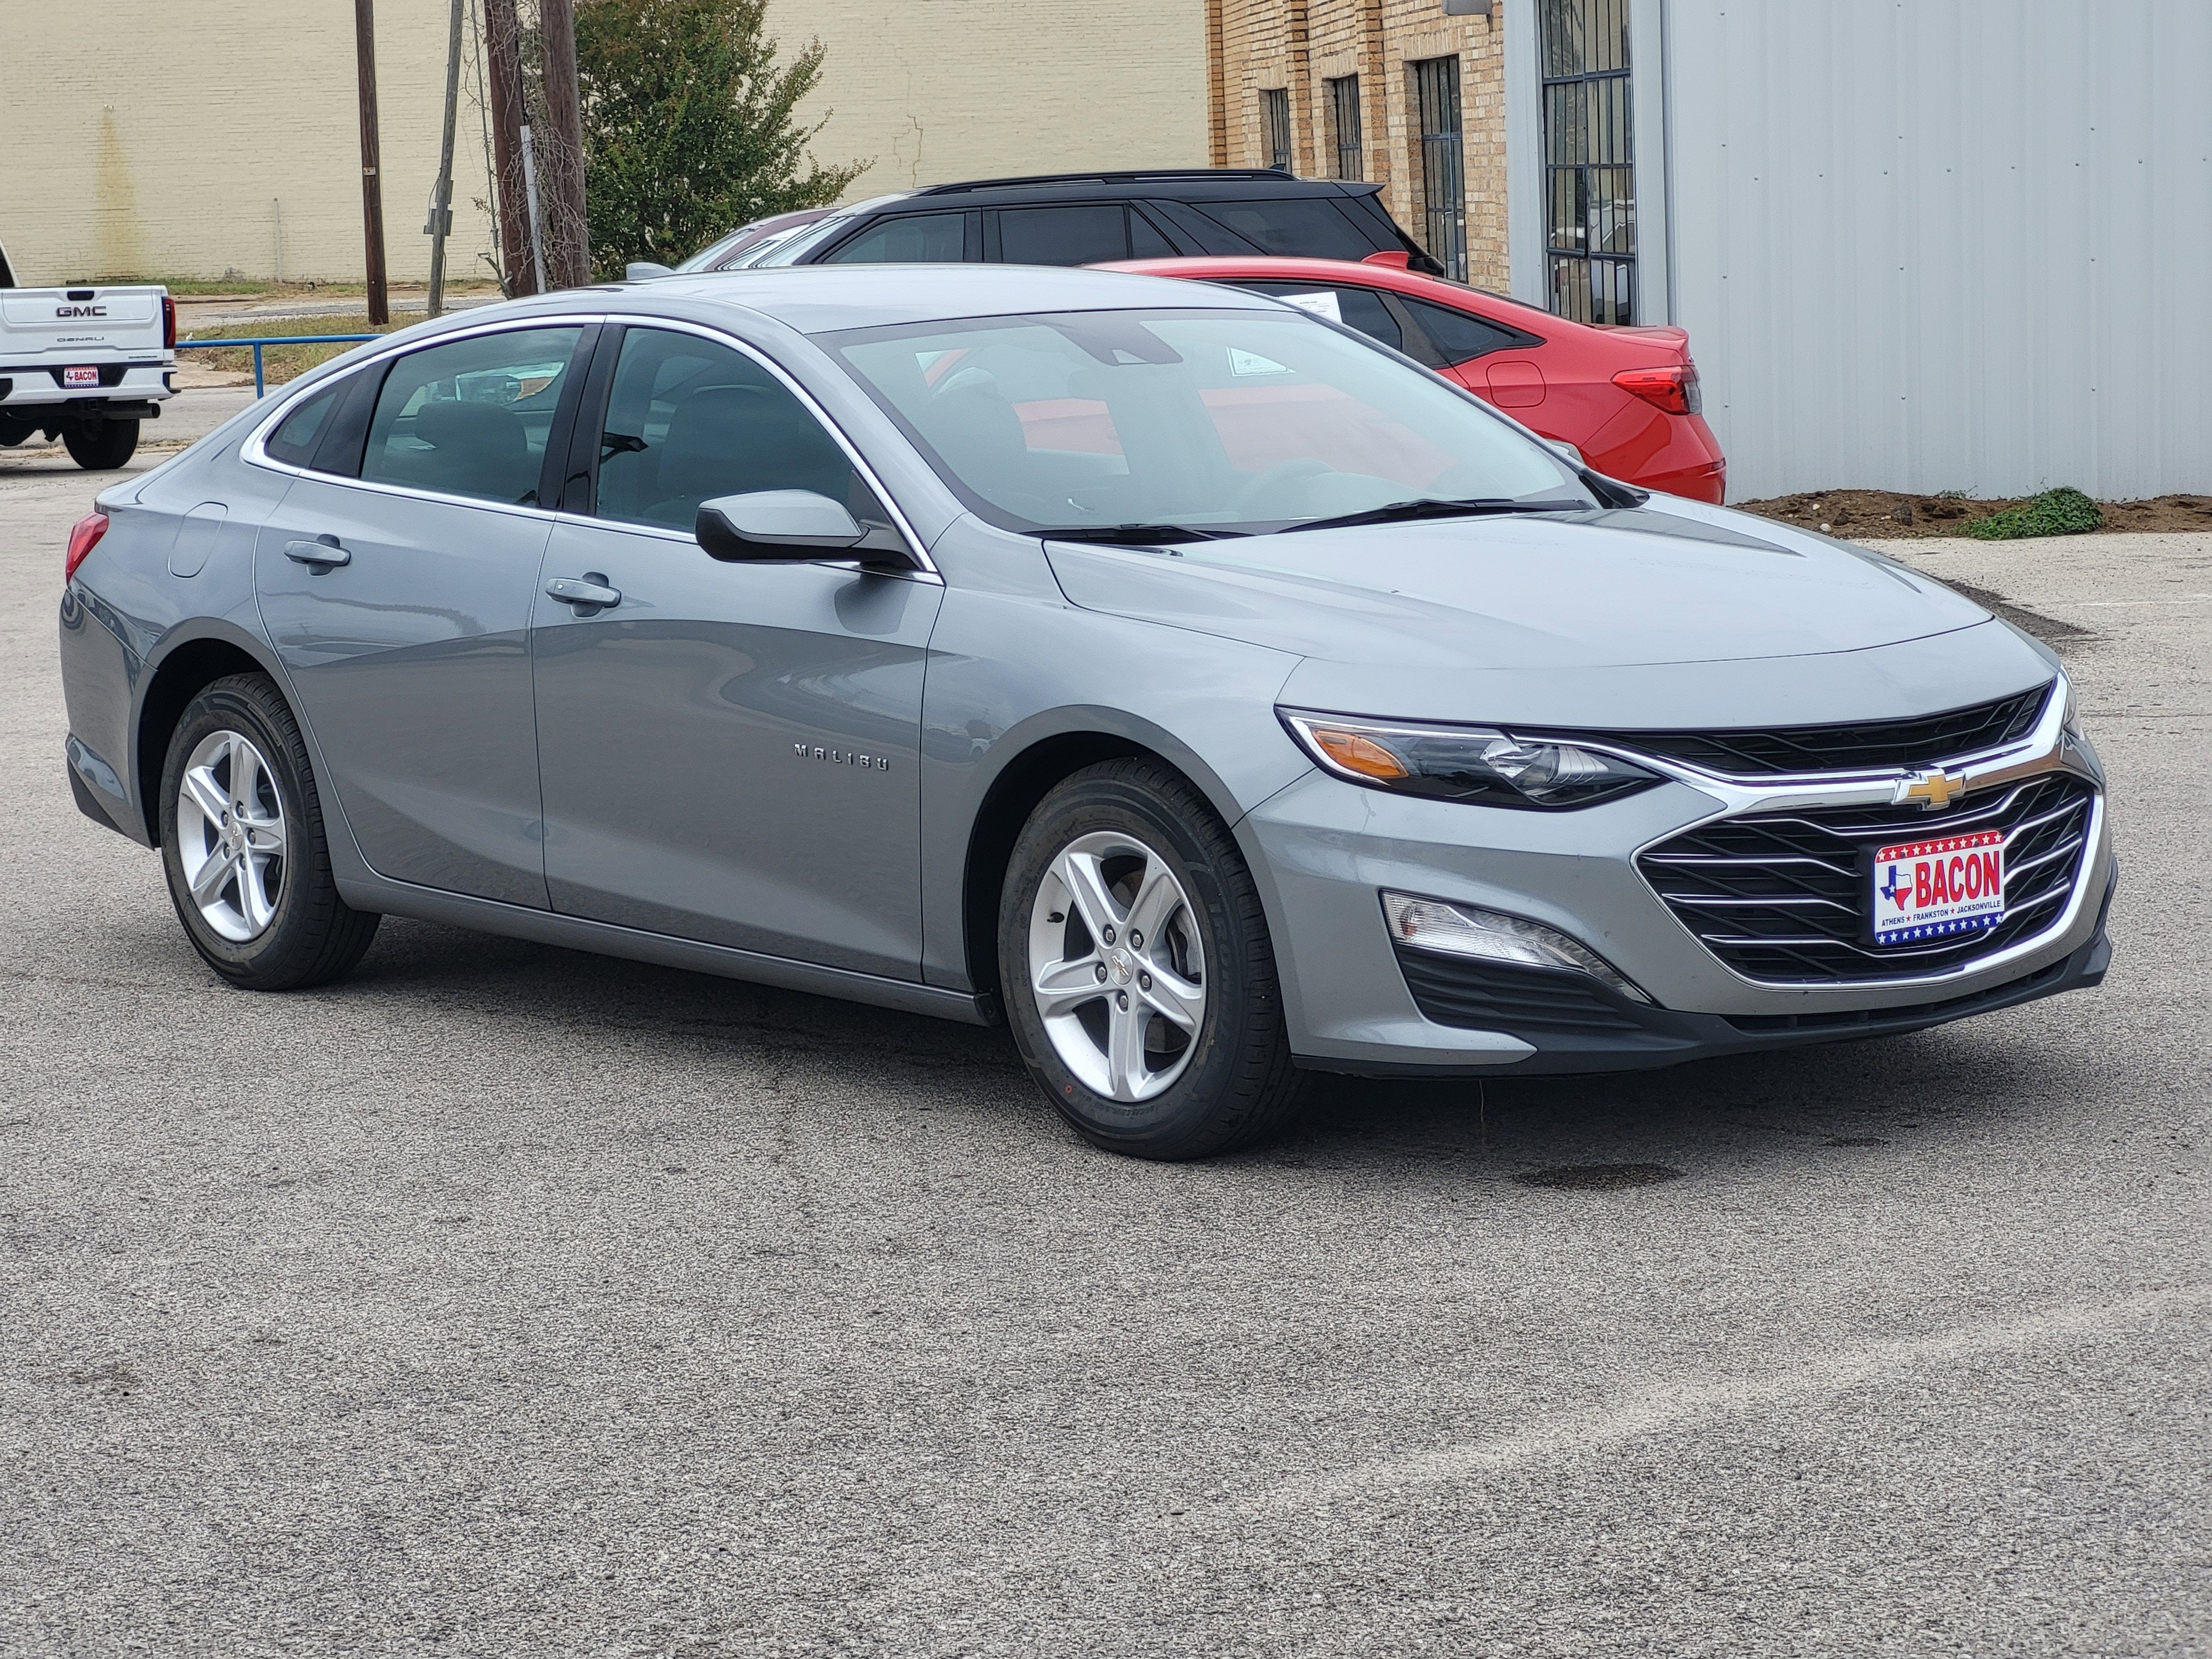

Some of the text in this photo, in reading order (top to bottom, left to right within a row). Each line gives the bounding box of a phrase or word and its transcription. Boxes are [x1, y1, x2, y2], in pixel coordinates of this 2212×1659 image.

[56, 306, 107, 317] GMC
[75, 371, 97, 380] BACON
[794, 743, 889, 770] MALIBU
[1914, 850, 2000, 909] BACON
[1881, 900, 2001, 927] ATHENS FRANKSTON JACKSONVILLE
